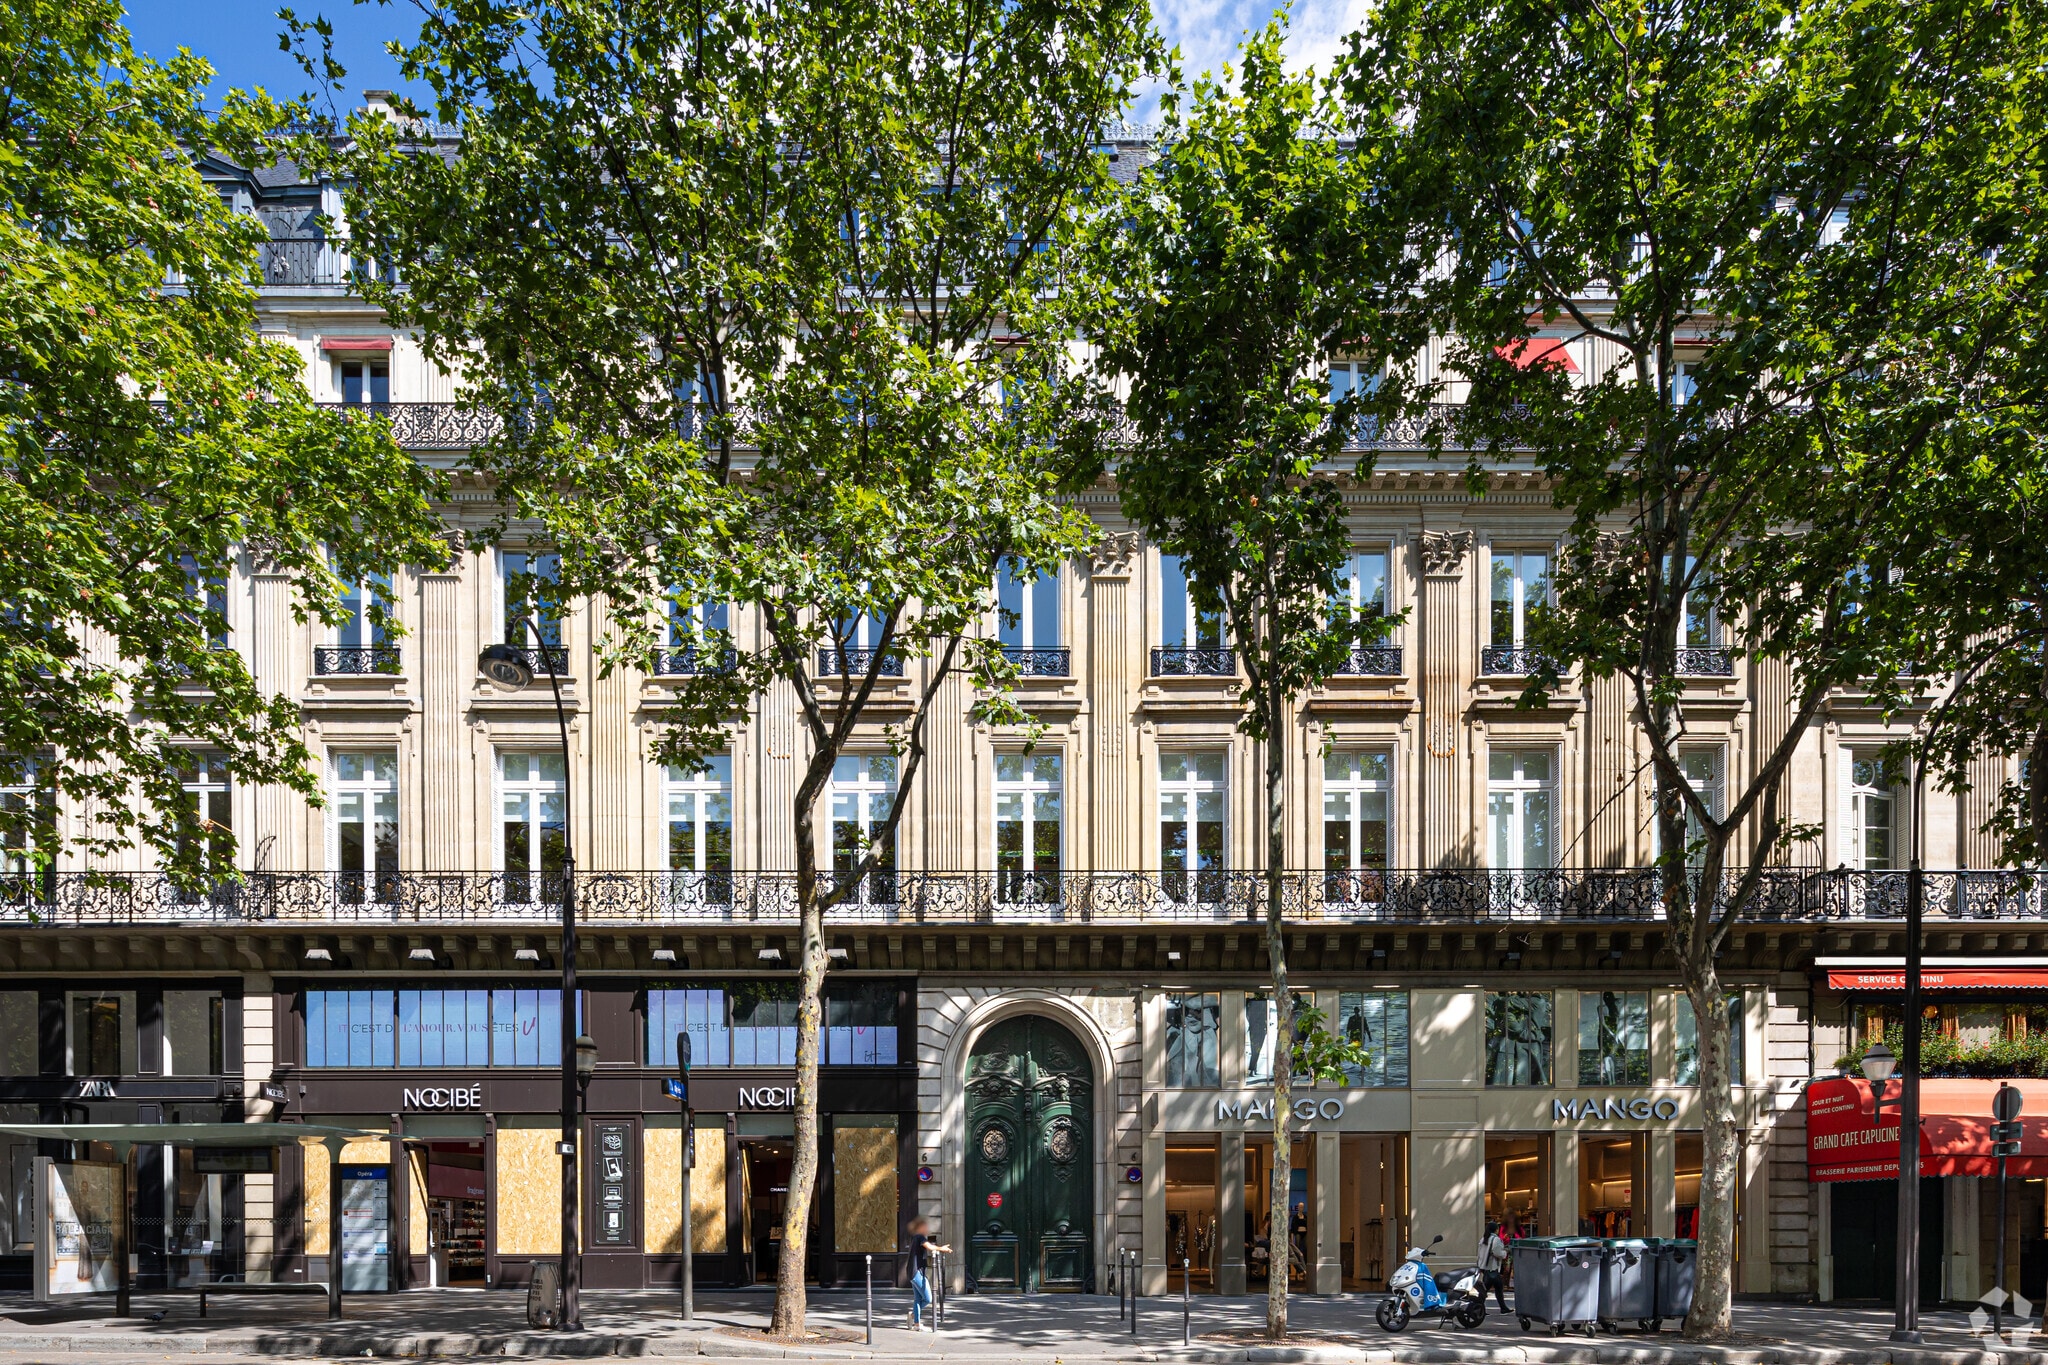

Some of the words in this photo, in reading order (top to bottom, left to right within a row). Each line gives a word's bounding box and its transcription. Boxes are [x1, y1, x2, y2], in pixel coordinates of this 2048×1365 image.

[1857, 975, 1897, 984] SERVICE
[1900, 975, 1944, 984] CTINU
[351, 1024, 381, 1034] C'EST
[79, 1080, 117, 1098] ZARA
[403, 1082, 482, 1108] NOCIBÉ
[739, 1086, 797, 1107] NOCI
[1811, 1098, 1825, 1107] JOUR
[1832, 1095, 1844, 1103] NUIT
[1217, 1097, 1345, 1121] MAGO
[1552, 1097, 1680, 1121] MANGO
[1811, 1107, 1831, 1116] SERVICE
[1831, 1103, 1855, 1113] CONTINU
[1813, 1134, 1839, 1150] GRAND
[1840, 1131, 1859, 1147] CAFE
[1860, 1126, 1900, 1144] CAPUCINE
[921, 1152, 928, 1162] 6
[1815, 1167, 1846, 1176] BRASSERIE
[1846, 1164, 1883, 1174] PARISIENNE
[56, 1223, 113, 1235] BALENCIAGA
